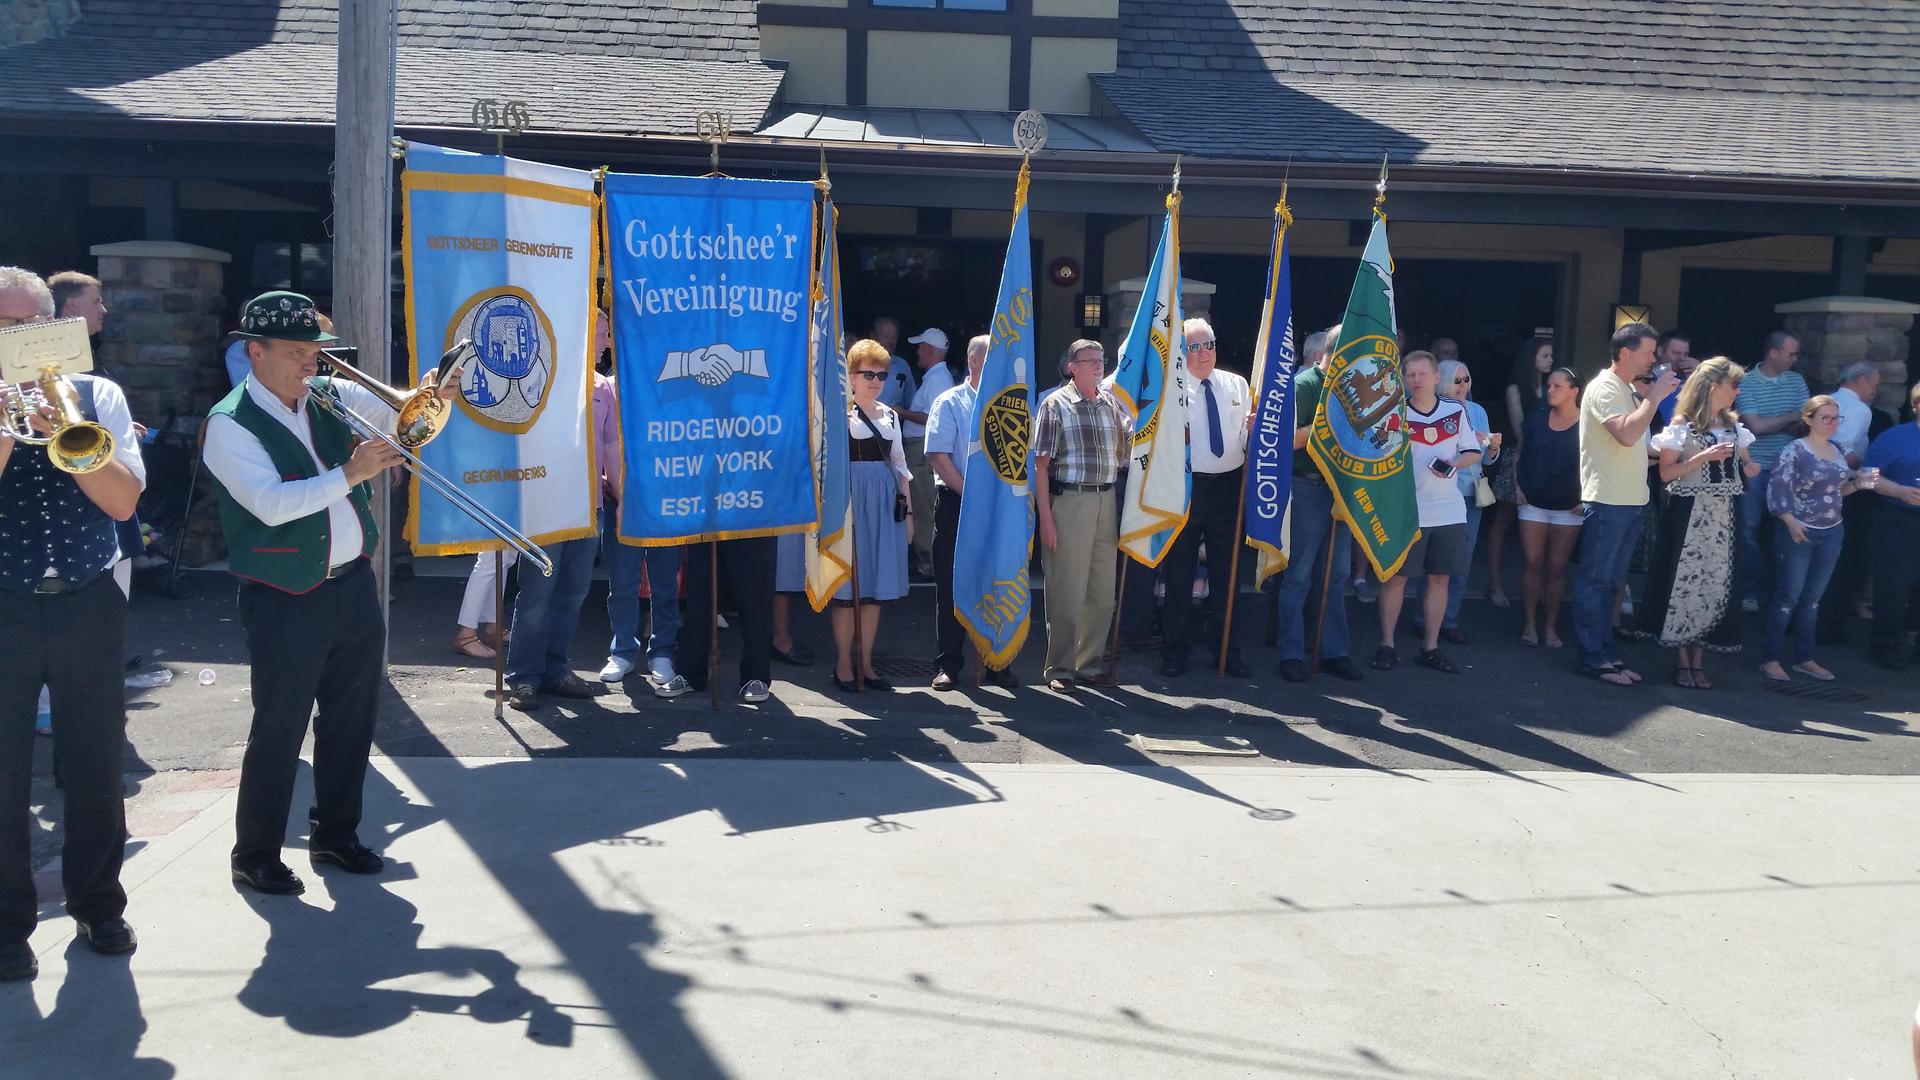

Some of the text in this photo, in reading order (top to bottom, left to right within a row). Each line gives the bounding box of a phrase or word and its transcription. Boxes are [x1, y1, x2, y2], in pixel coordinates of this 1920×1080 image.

[1018, 119, 1045, 140] GBC
[427, 235, 498, 251] GOTTSCHEER
[625, 219, 798, 260] Gottschee'r
[622, 272, 803, 322] Vereinigung
[1001, 395, 1028, 408] FRIEN
[647, 415, 782, 442] RIDGEWOOD
[985, 414, 1012, 477] ATHLETICS
[1256, 391, 1286, 519] GOTTSCHEER
[654, 450, 774, 478] NEW YORK
[1330, 446, 1365, 474] CLUB
[1372, 458, 1403, 475] INC.
[661, 490, 764, 516] EST. 1935
[1353, 487, 1390, 546] NEW YORK
